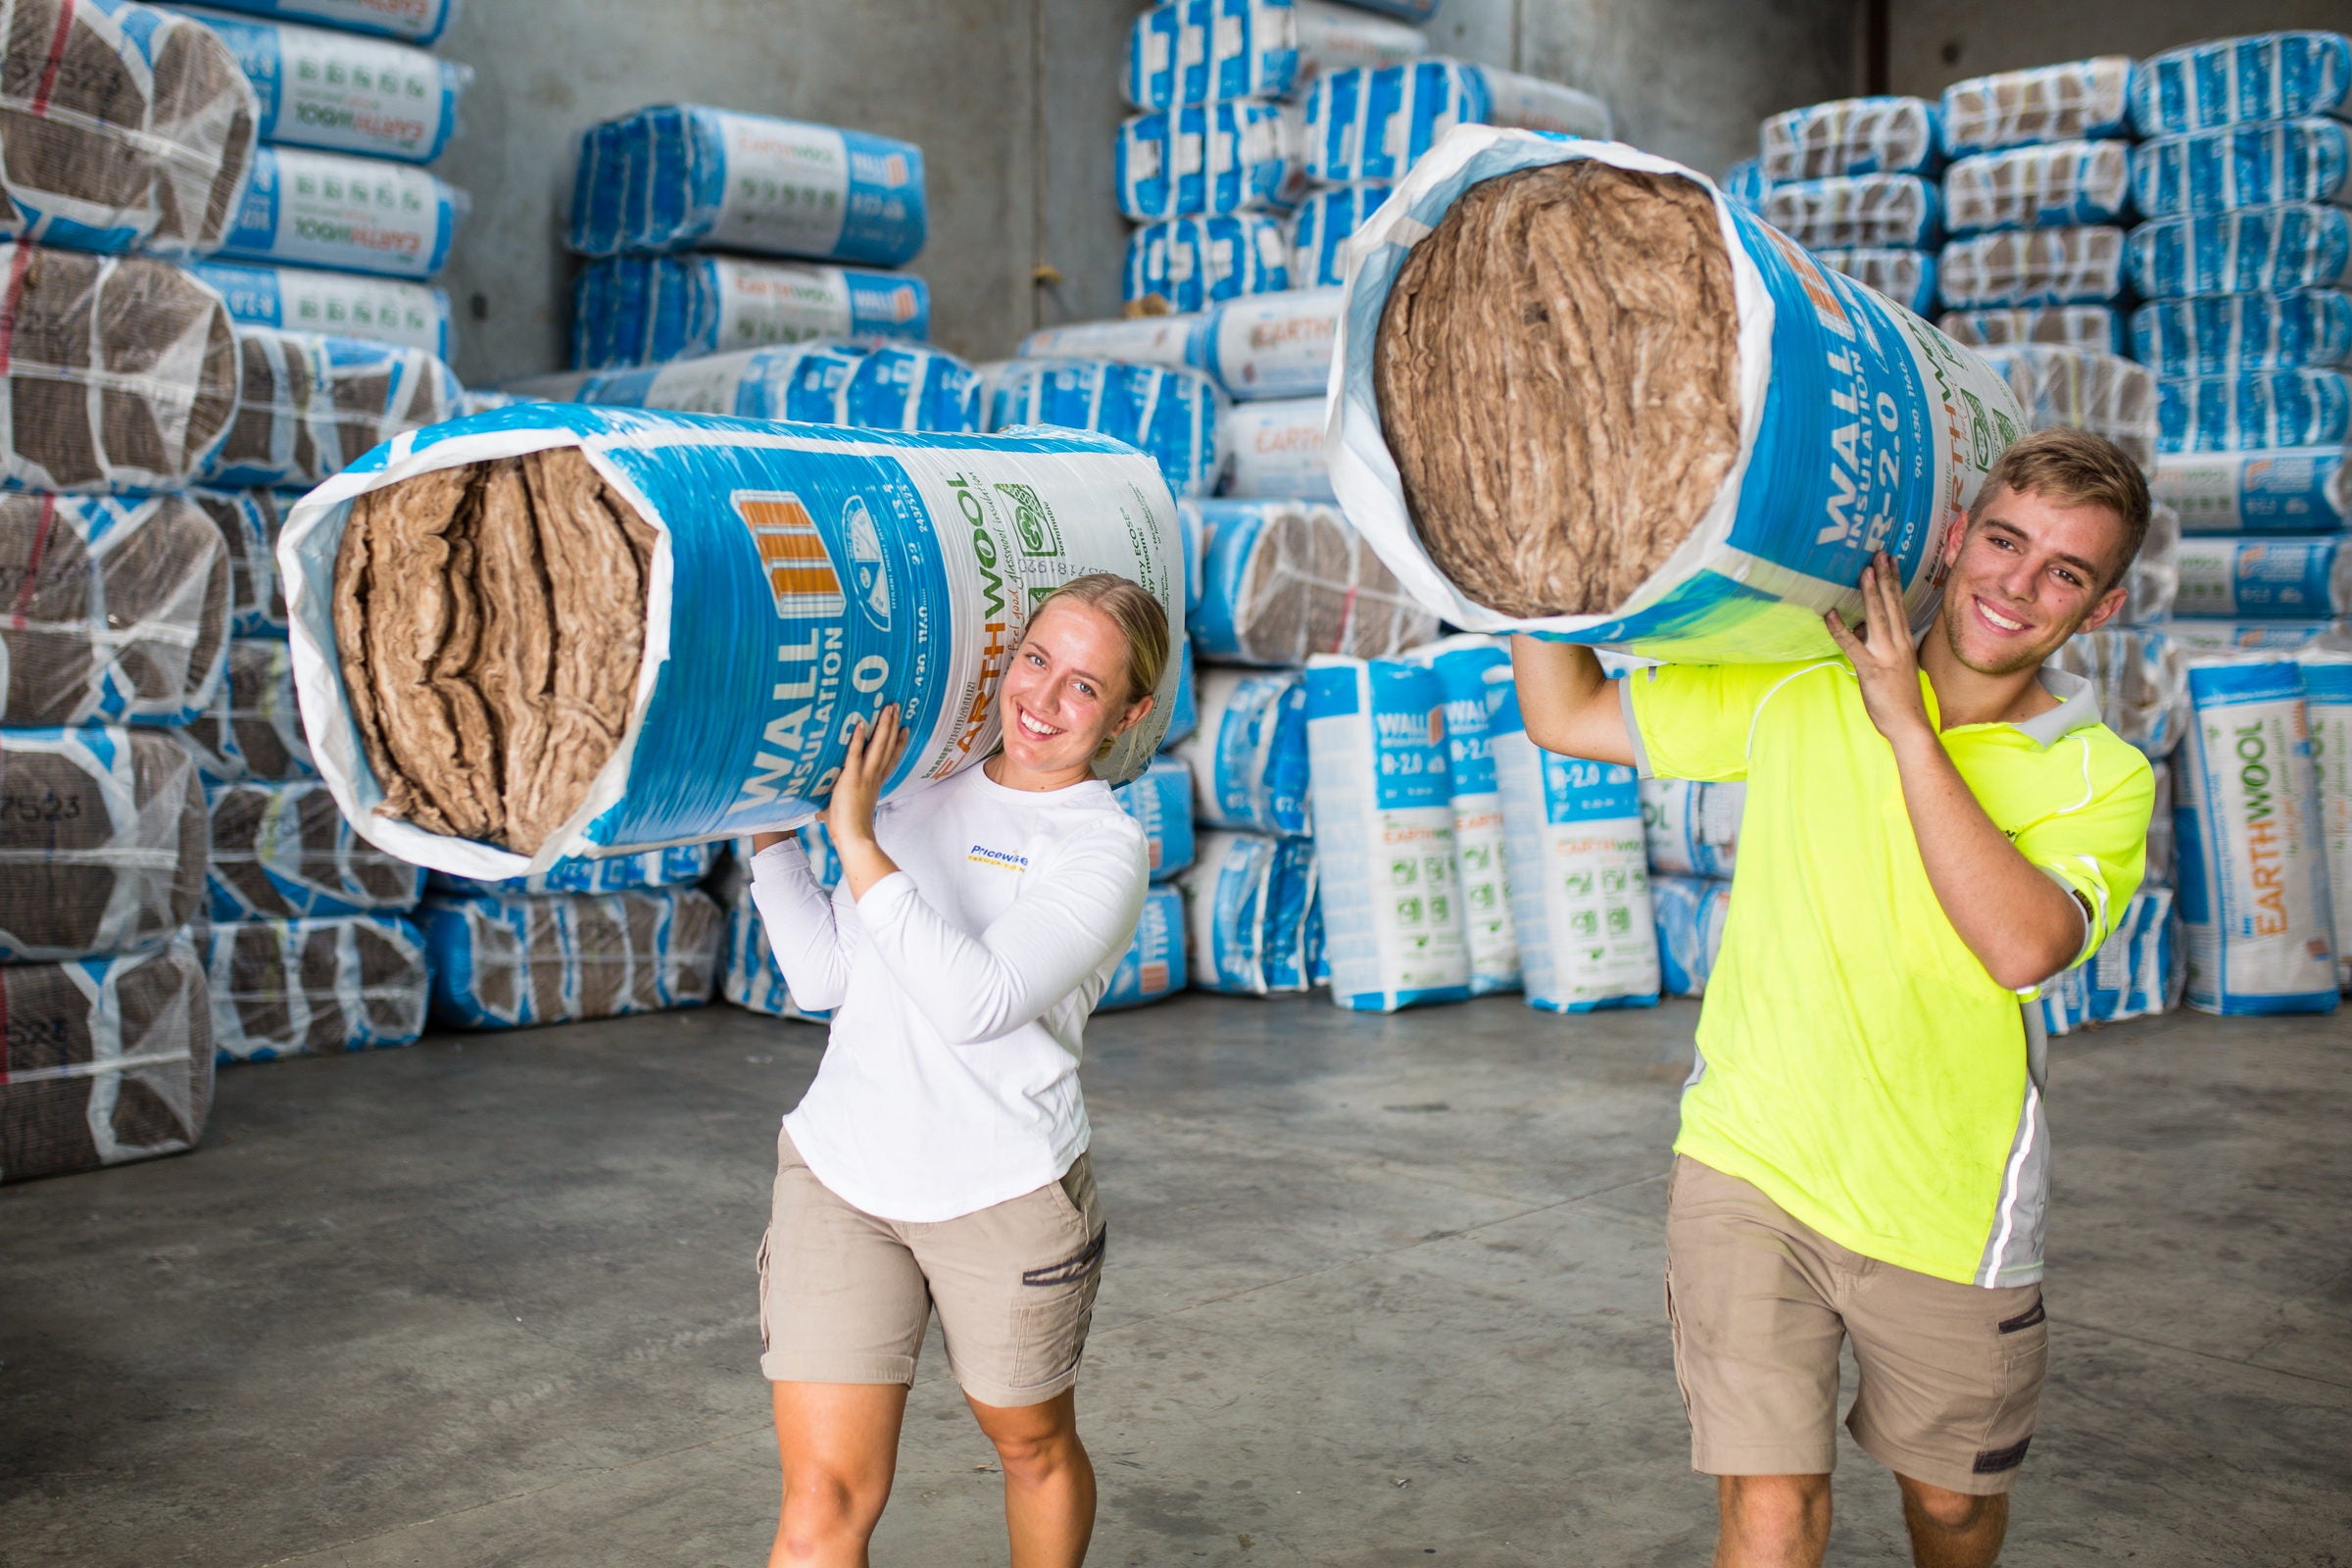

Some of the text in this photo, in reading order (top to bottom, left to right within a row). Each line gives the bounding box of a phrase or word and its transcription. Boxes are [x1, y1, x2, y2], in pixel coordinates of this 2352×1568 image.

[295, 218, 422, 252] EARTHWOOL
[1817, 341, 1861, 545] WALL
[1844, 350, 1873, 550] INSULATION
[1911, 408, 1922, 446] 430
[1864, 391, 1900, 554] R-2.0
[1914, 453, 1923, 478] 90
[968, 470, 1002, 531] insulation
[1043, 501, 1066, 557] Sustainable
[1137, 527, 1152, 574] means:
[997, 529, 1023, 590] glasswool
[932, 470, 1004, 781] EARTHWOOL
[1009, 589, 1026, 625] good
[1006, 625, 1020, 651] feel
[727, 627, 819, 815] WALL
[776, 627, 843, 806] INSULATION
[905, 696, 920, 719] 90
[1377, 713, 1429, 734] WALL
[1445, 700, 1489, 724] WAL
[1550, 762, 1600, 792] R-2.0
[2234, 718, 2288, 936] EARTHWOOL
